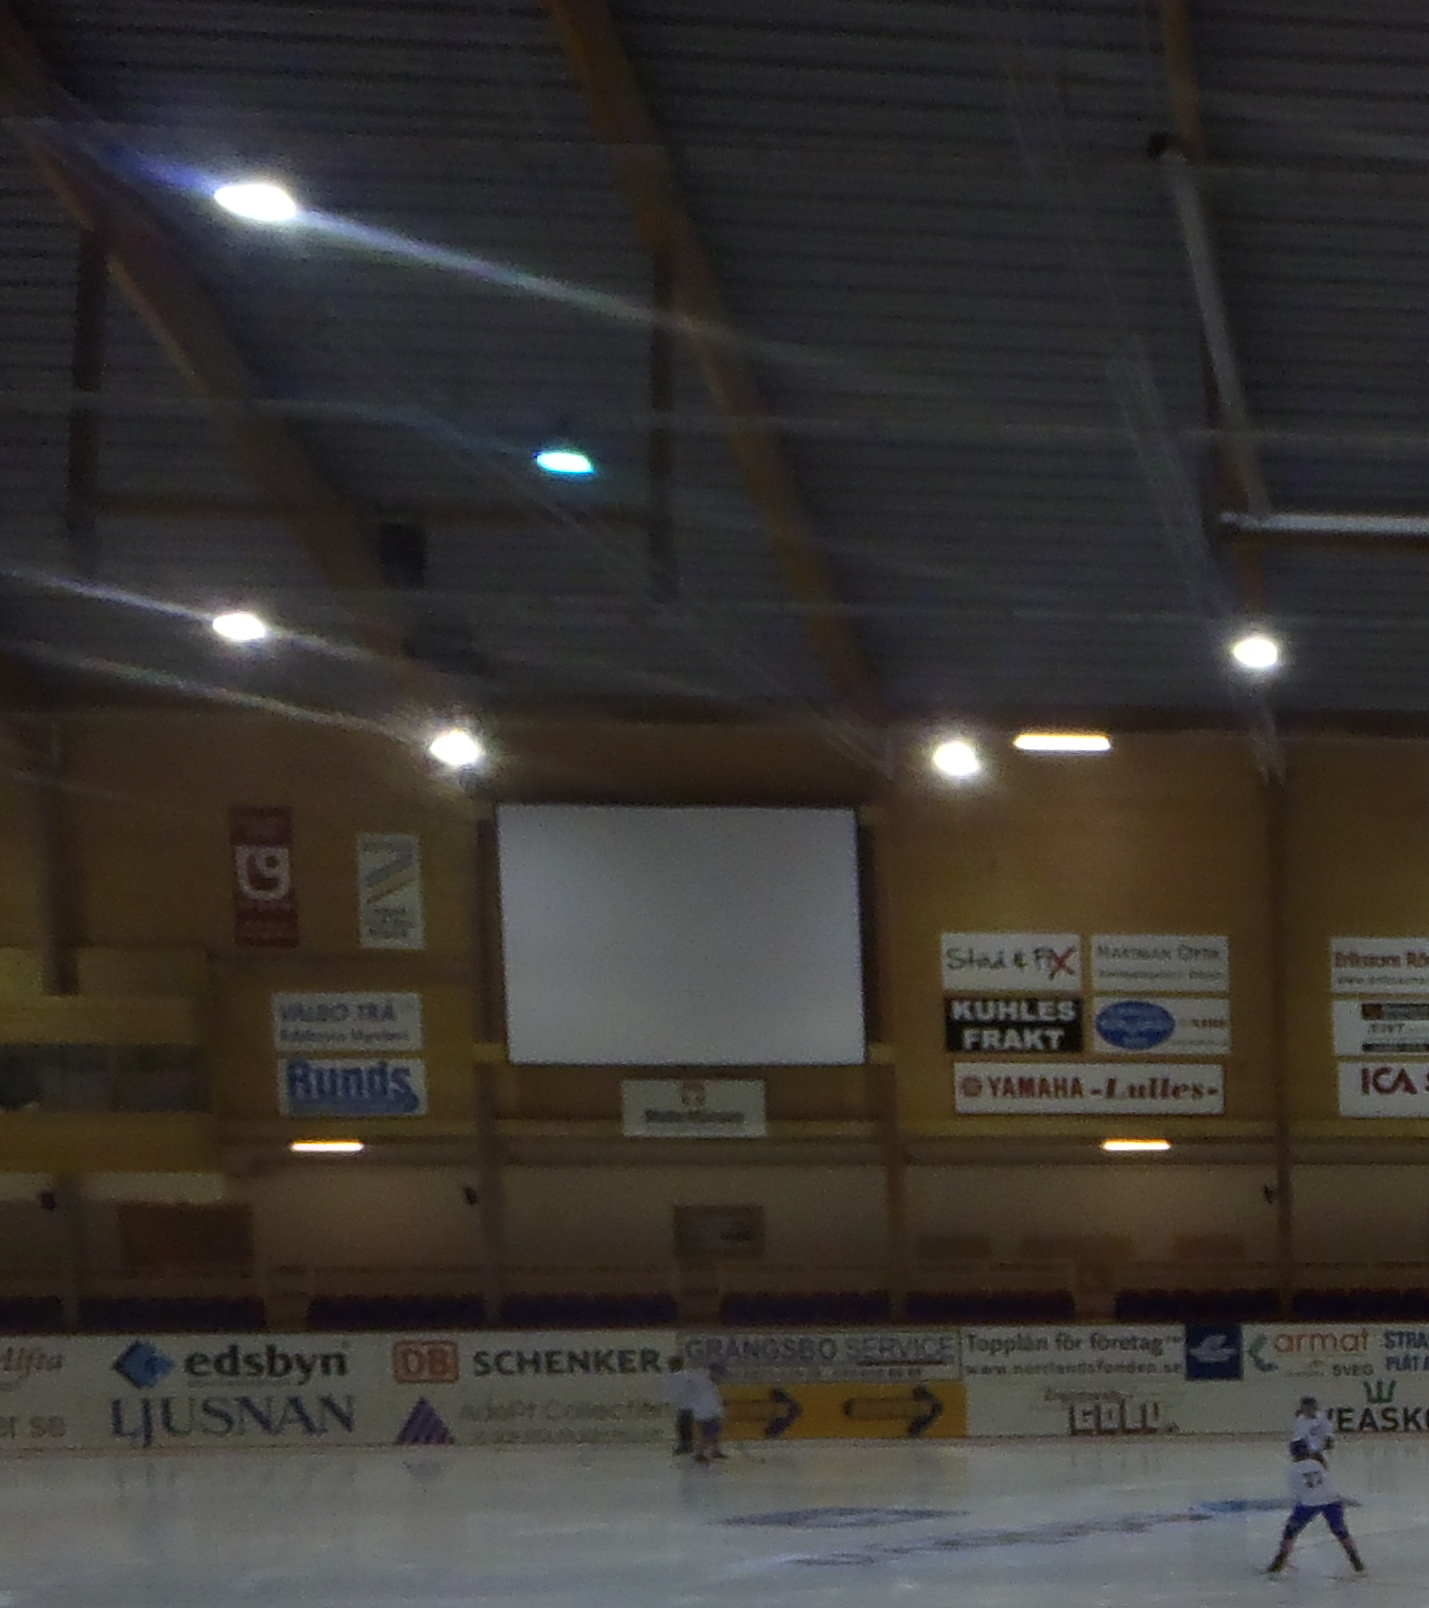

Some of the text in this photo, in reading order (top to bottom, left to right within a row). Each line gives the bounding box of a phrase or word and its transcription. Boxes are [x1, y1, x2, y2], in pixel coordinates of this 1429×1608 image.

[951, 1000, 1078, 1023] KUHLES
[963, 1028, 1067, 1051] FRAKT
[986, 1076, 1084, 1100] YAMAHA
[1360, 1066, 1418, 1096] ICA
[846, 1337, 955, 1363] SERVICE
[1056, 1332, 1084, 1352] för
[185, 1343, 348, 1385] edsbyn
[473, 1350, 662, 1376] SCHENKER
[1333, 1363, 1374, 1378] SVEG
[111, 1396, 355, 1448] LJUSNAN
